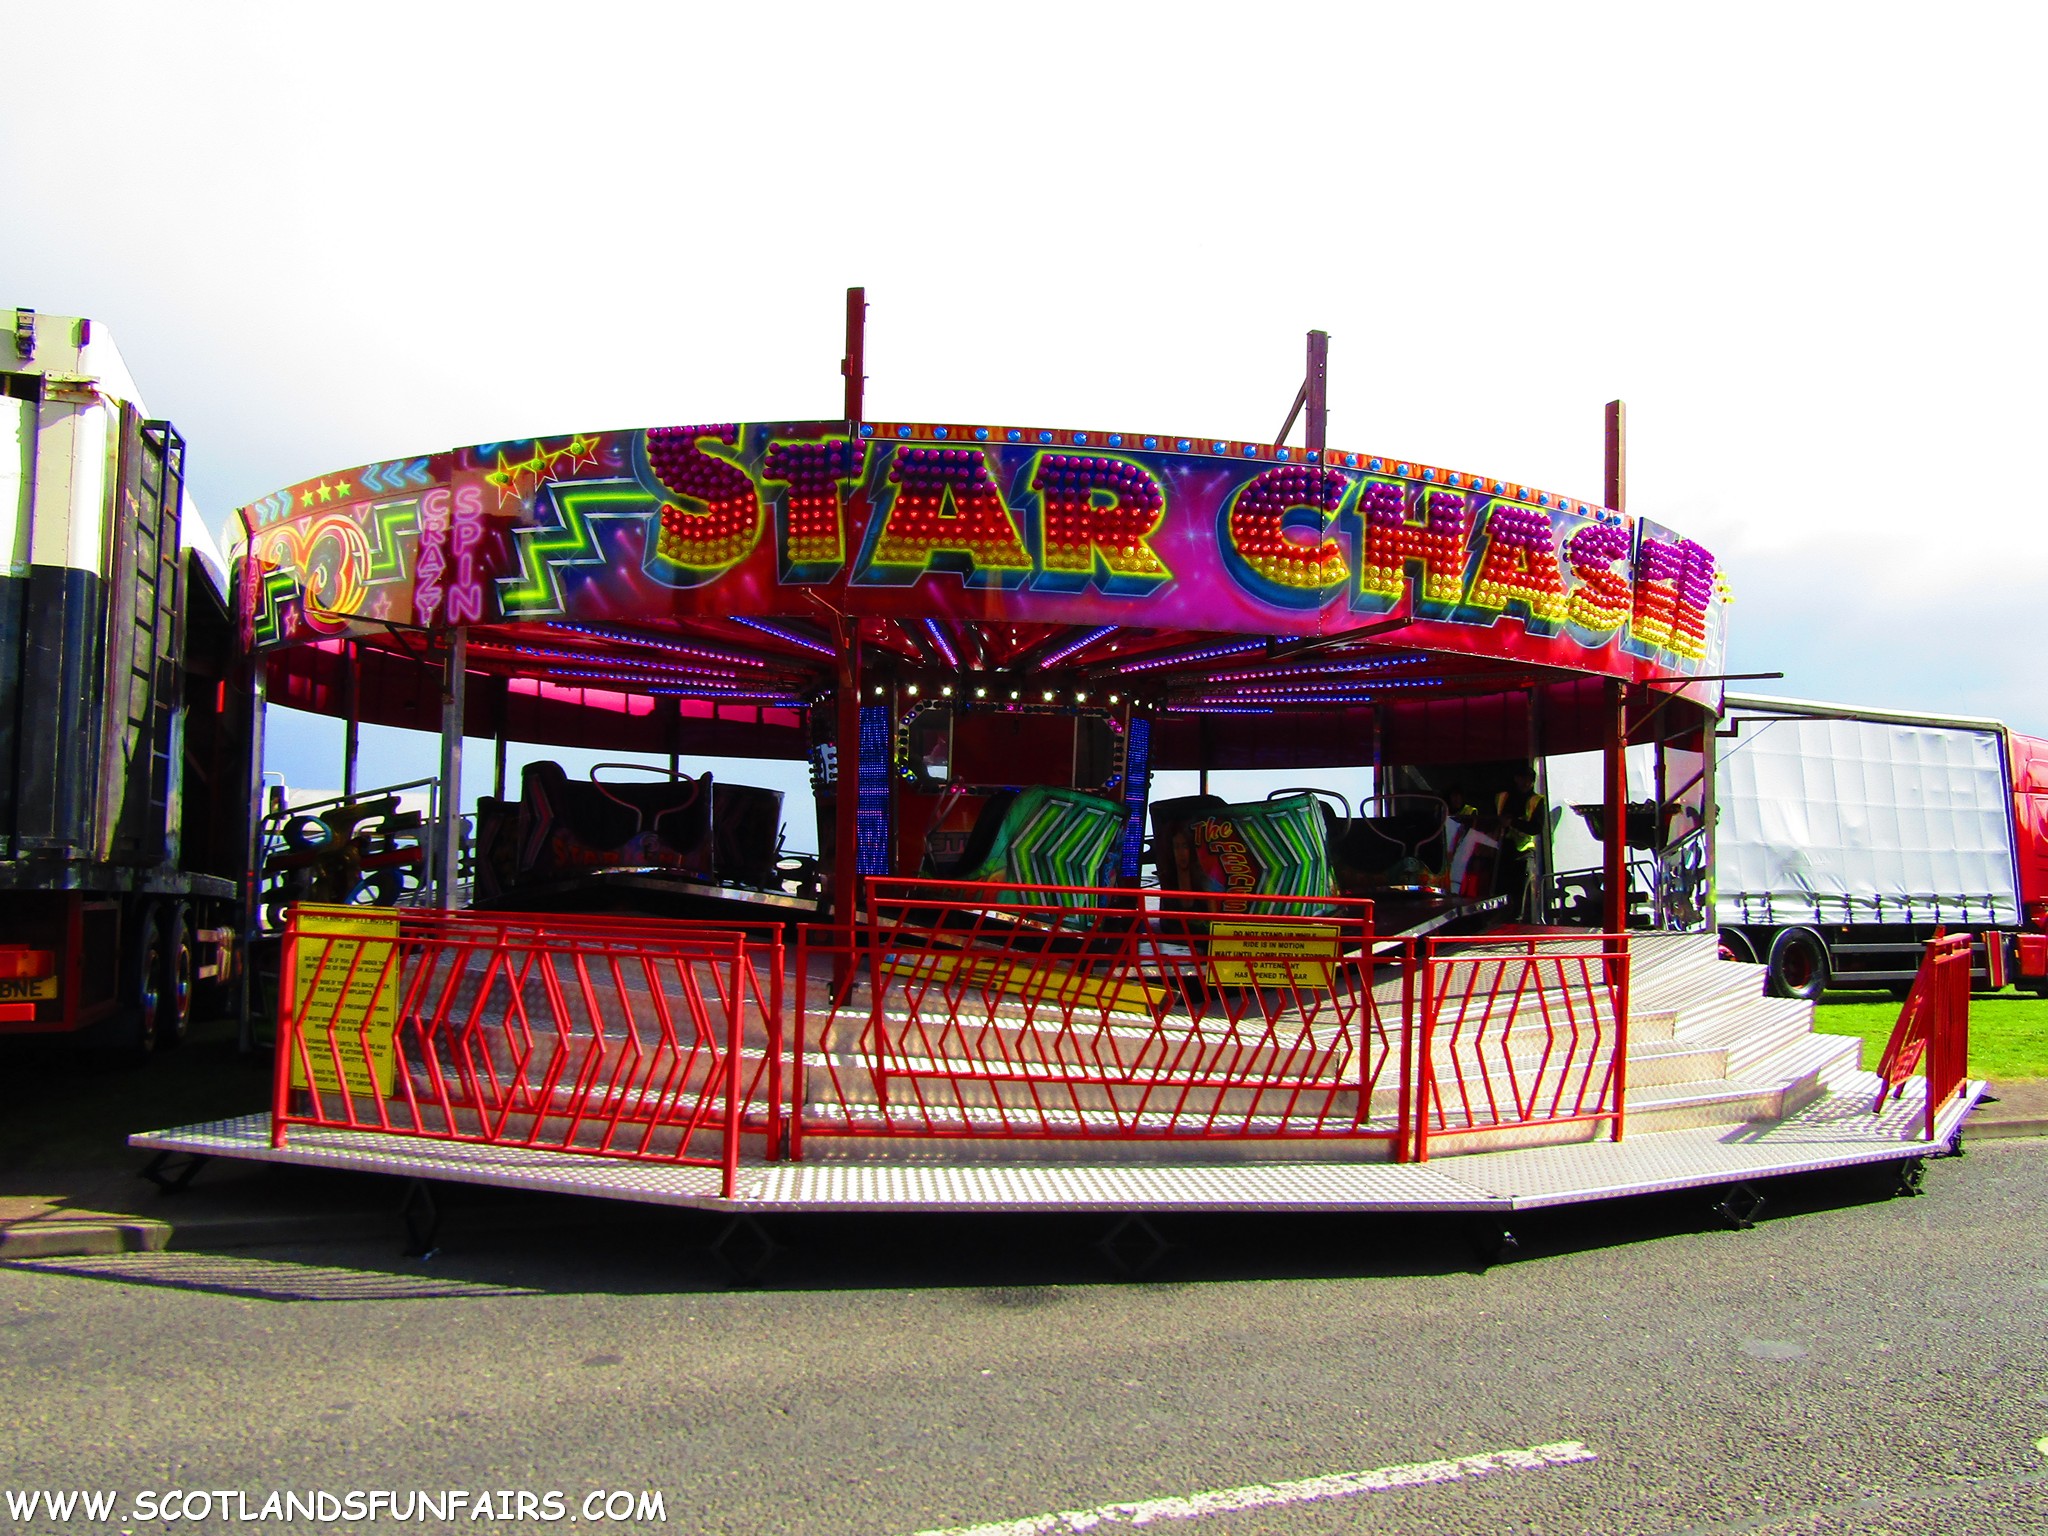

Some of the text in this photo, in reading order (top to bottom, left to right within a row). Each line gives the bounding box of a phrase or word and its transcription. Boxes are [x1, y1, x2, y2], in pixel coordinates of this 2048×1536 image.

[646, 421, 1174, 585] STAR
[417, 489, 450, 626] CRAZY
[449, 485, 482, 624] SPIN
[1191, 816, 1233, 845] The
[1234, 971, 1248, 979] HAS
[1251, 972, 1277, 980] PENED
[1243, 941, 1259, 949] RIDE
